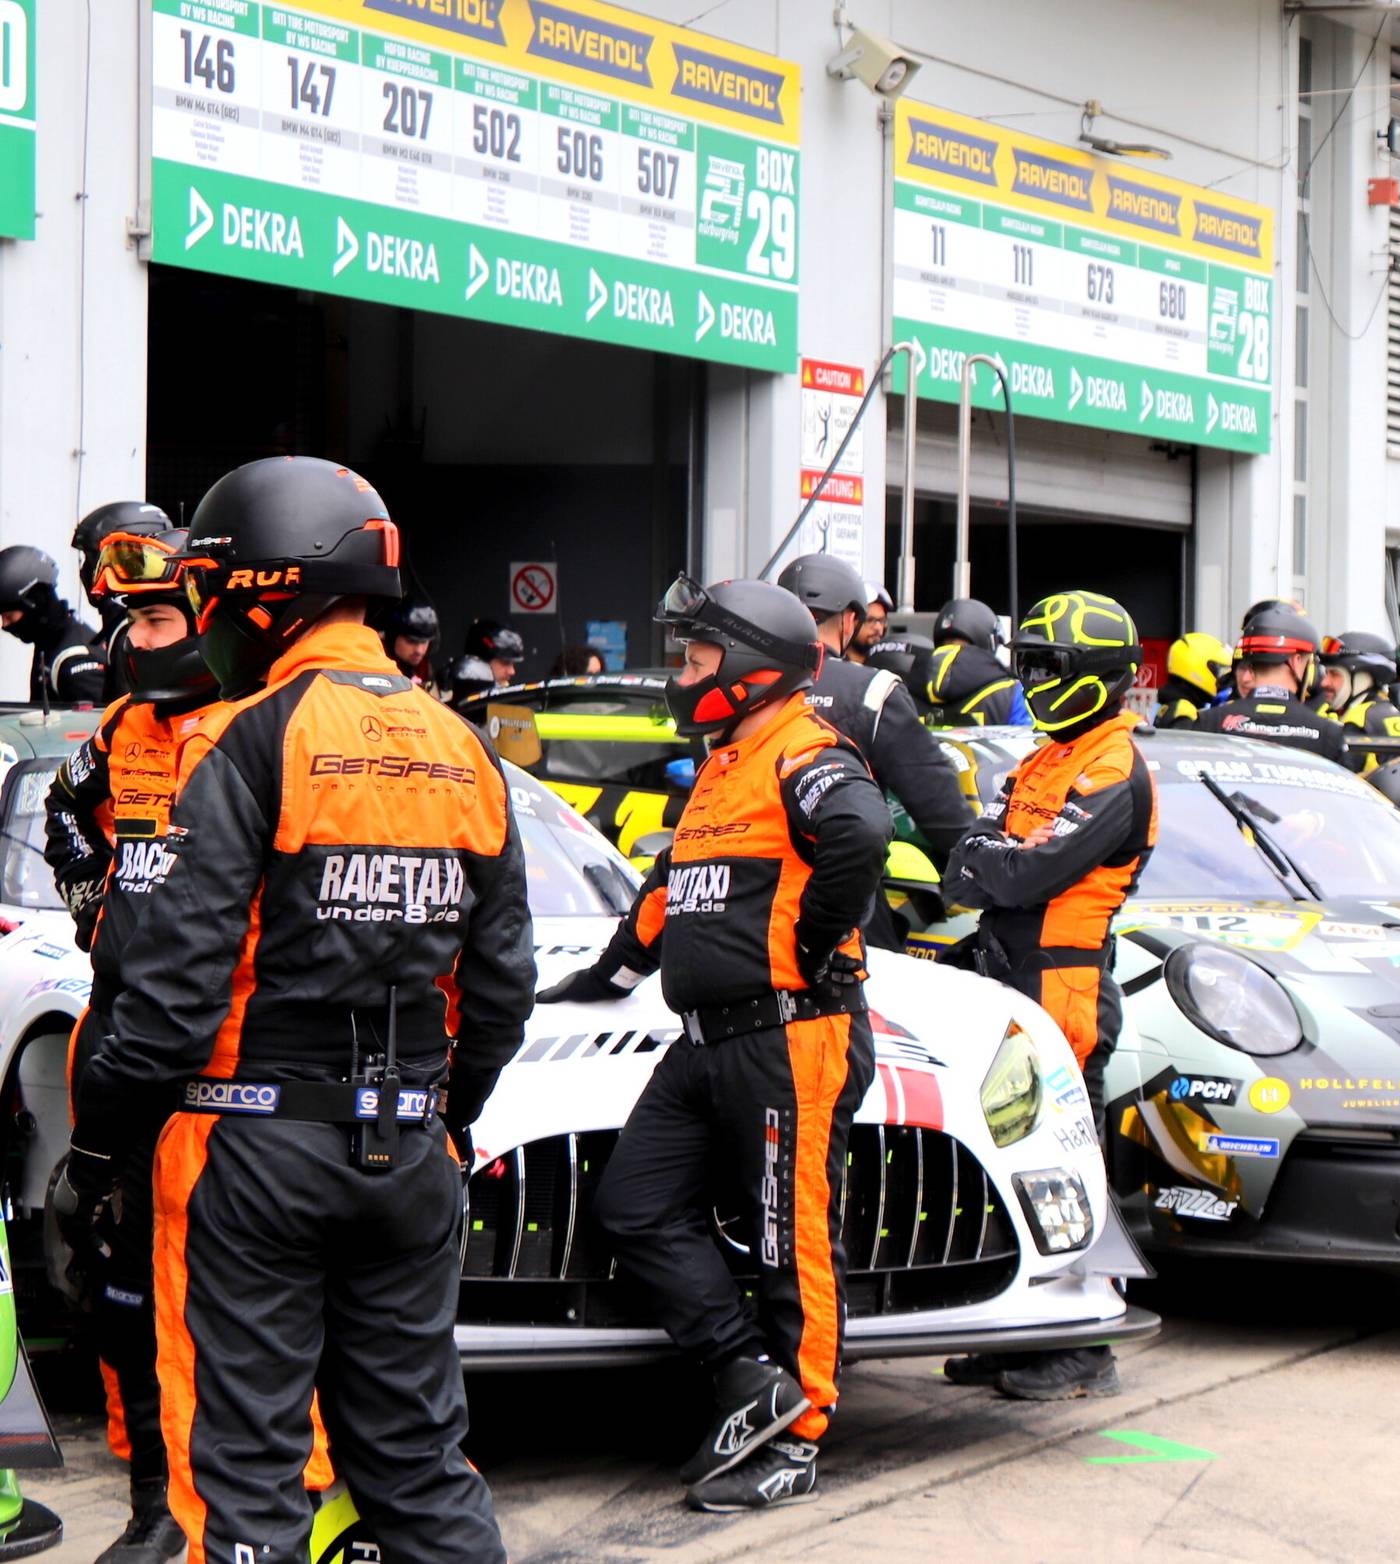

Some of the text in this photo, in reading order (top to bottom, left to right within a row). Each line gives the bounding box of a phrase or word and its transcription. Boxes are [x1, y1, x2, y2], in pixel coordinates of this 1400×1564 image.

[207, 9, 235, 29] RACING
[304, 18, 349, 43] MOTORSPORT
[180, 28, 235, 93] 146
[286, 30, 297, 45] BY
[311, 37, 336, 56] RACING
[288, 56, 336, 117] 147
[539, 21, 644, 72] RAVENOL
[683, 62, 775, 110] RAVENOL
[176, 95, 193, 109] BMW
[195, 99, 205, 111] M4
[207, 102, 219, 115] GT4
[383, 81, 433, 140] 207
[282, 119, 298, 134] BMW
[473, 104, 521, 162] 502
[557, 125, 603, 182] 506
[638, 146, 680, 200] 507
[756, 146, 795, 195] BOX
[915, 132, 1257, 247] RAVENOL RAVENOL RAVENOL RAVENOL
[746, 190, 795, 280] 29
[931, 224, 946, 266] 11
[223, 202, 776, 346] DEKRA DEKRA DEKRA DEKRA DEKRA
[1013, 244, 1033, 286] 111
[1088, 263, 1114, 304] 673
[1160, 280, 1186, 321] 680
[1244, 276, 1269, 314] BOX
[1238, 311, 1270, 382] 28
[816, 367, 852, 388] CAUTION
[1012, 361, 1055, 398] DEKRA
[1087, 375, 1127, 412] DEKRA
[1157, 388, 1194, 424] DEKRA
[1221, 404, 1257, 434] DEKRA
[812, 475, 854, 497] AHTUNG
[804, 694, 834, 708] cing
[1280, 724, 1320, 739] Racing
[310, 754, 476, 785] GETSPEED
[319, 853, 465, 905] RACETAXI
[185, 1081, 277, 1107] sparco
[1188, 1080, 1232, 1100] PCH
[1220, 1141, 1272, 1153] MICHELIN
[761, 1107, 779, 1268] GETSPEED
